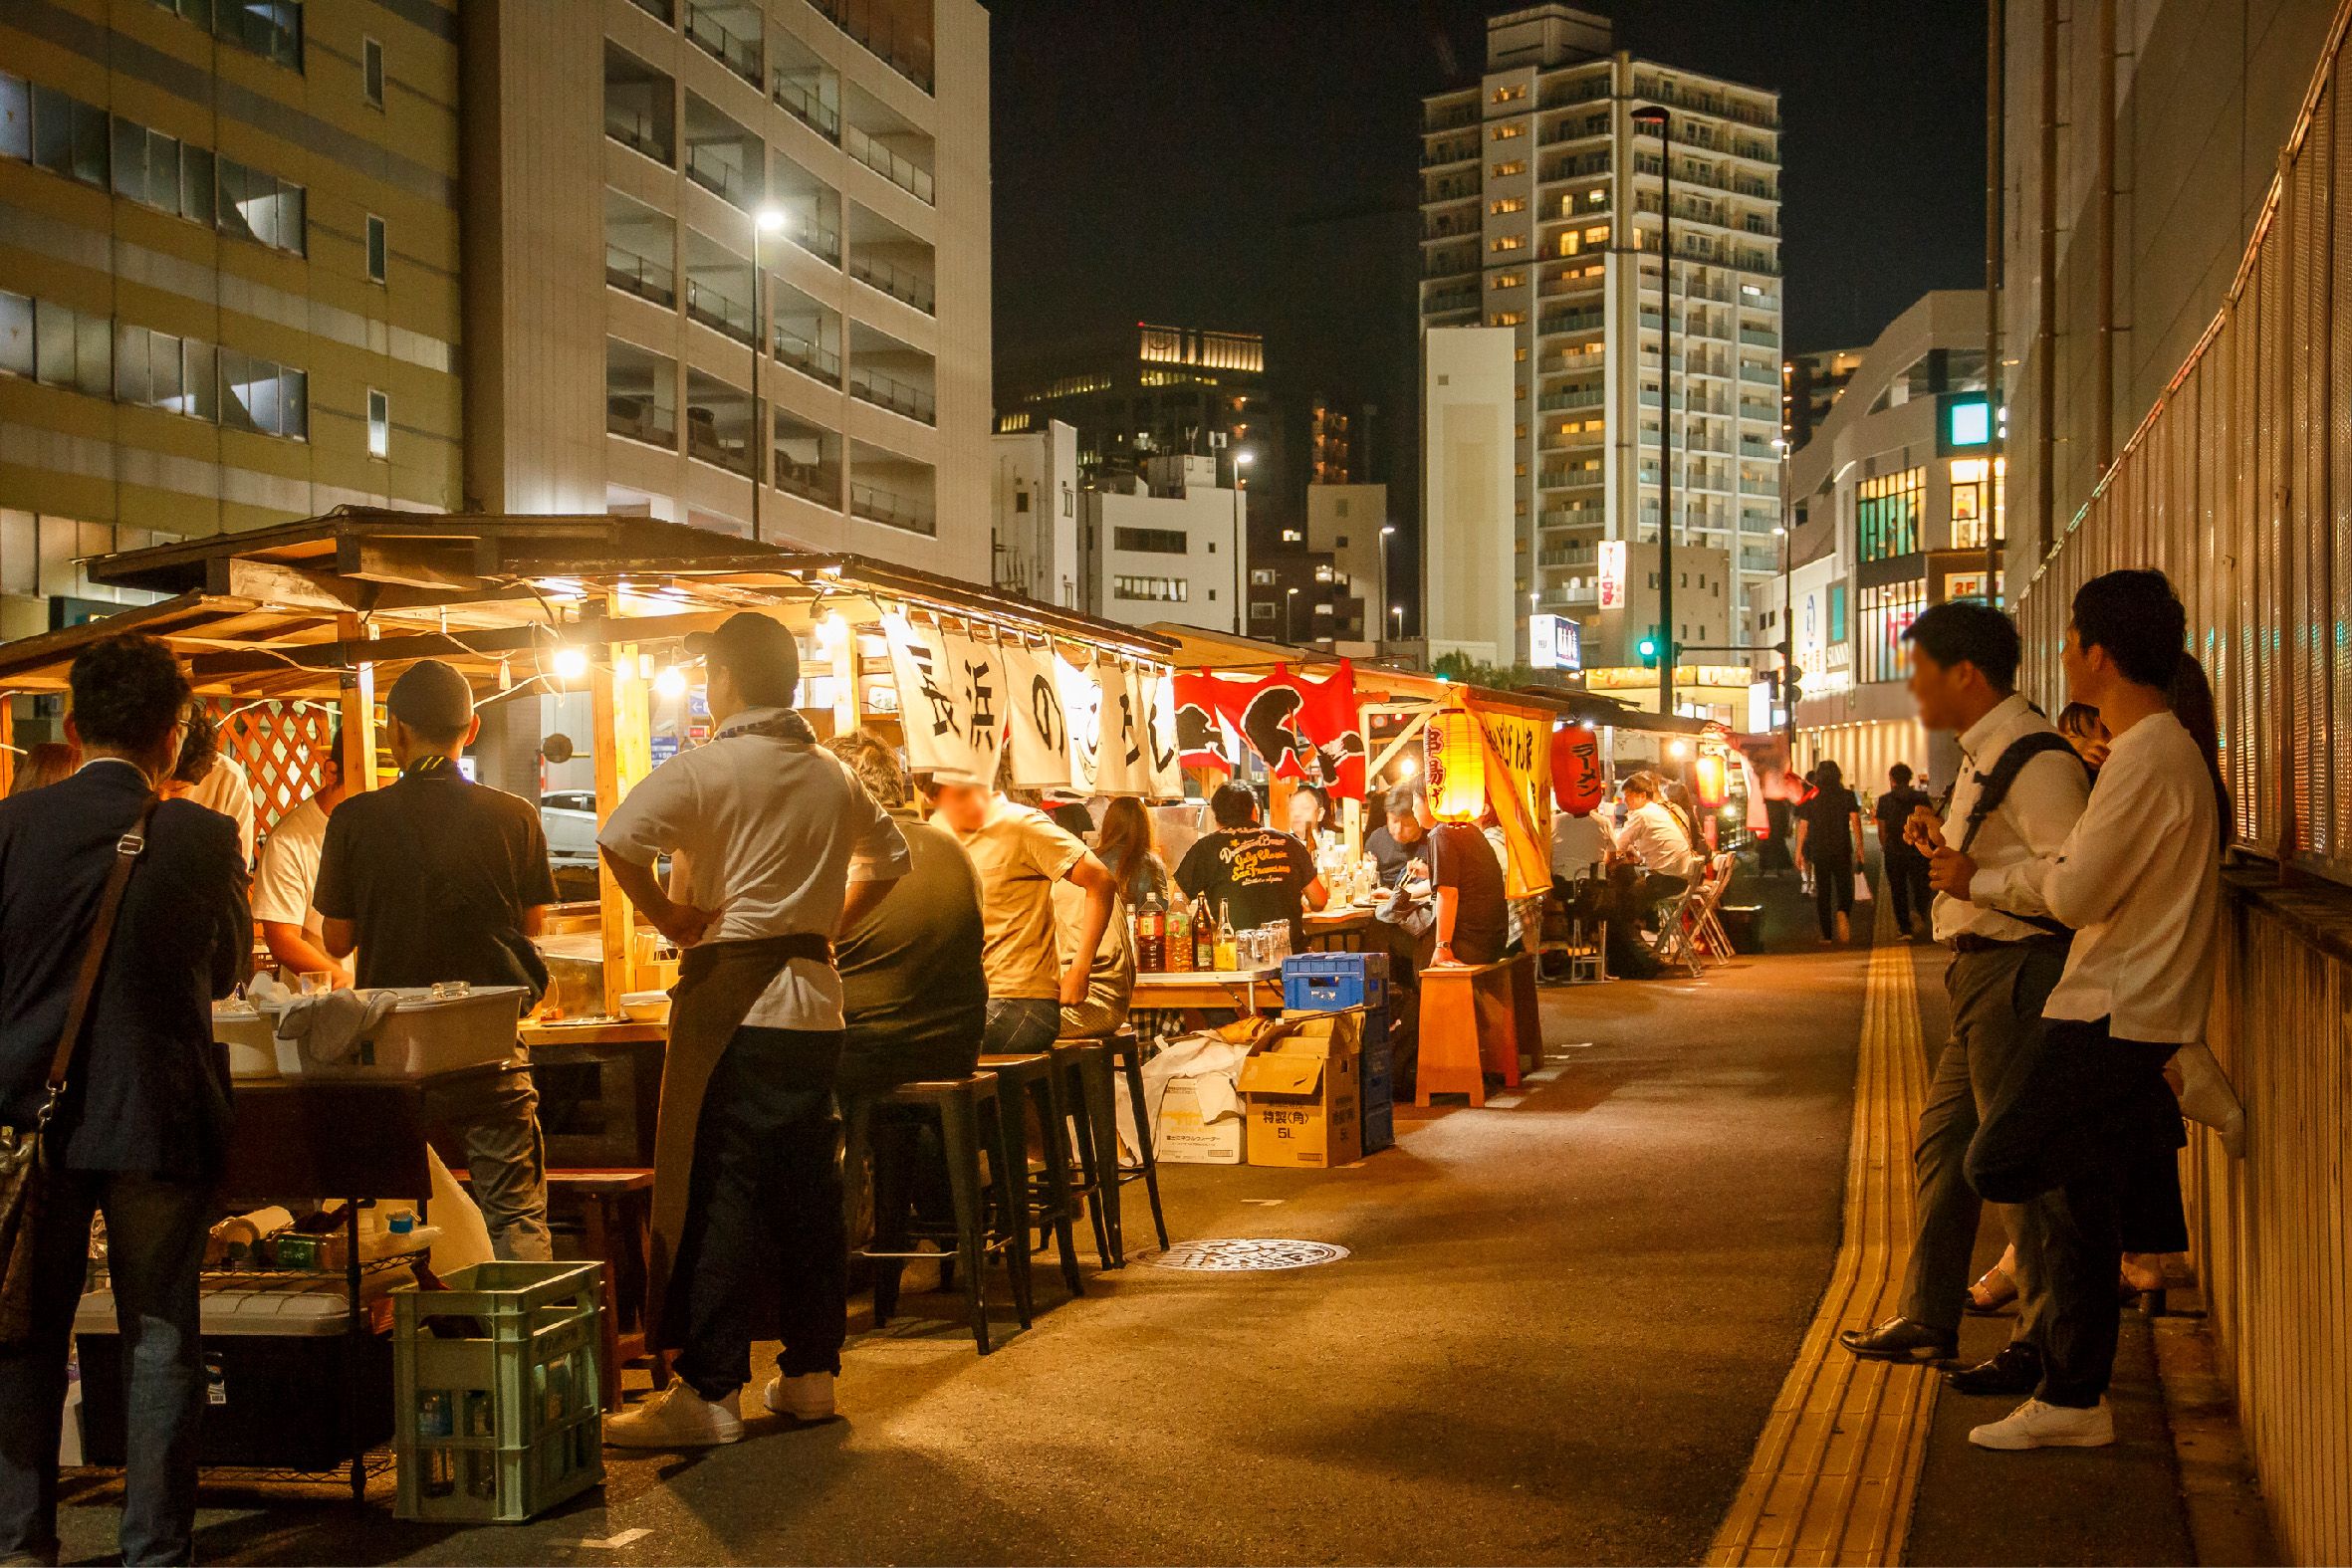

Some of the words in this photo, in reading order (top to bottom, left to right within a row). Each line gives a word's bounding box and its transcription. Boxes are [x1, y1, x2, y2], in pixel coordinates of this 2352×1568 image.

[1571, 743, 1598, 796] ラーメン
[1278, 1127, 1295, 1139] 5L
